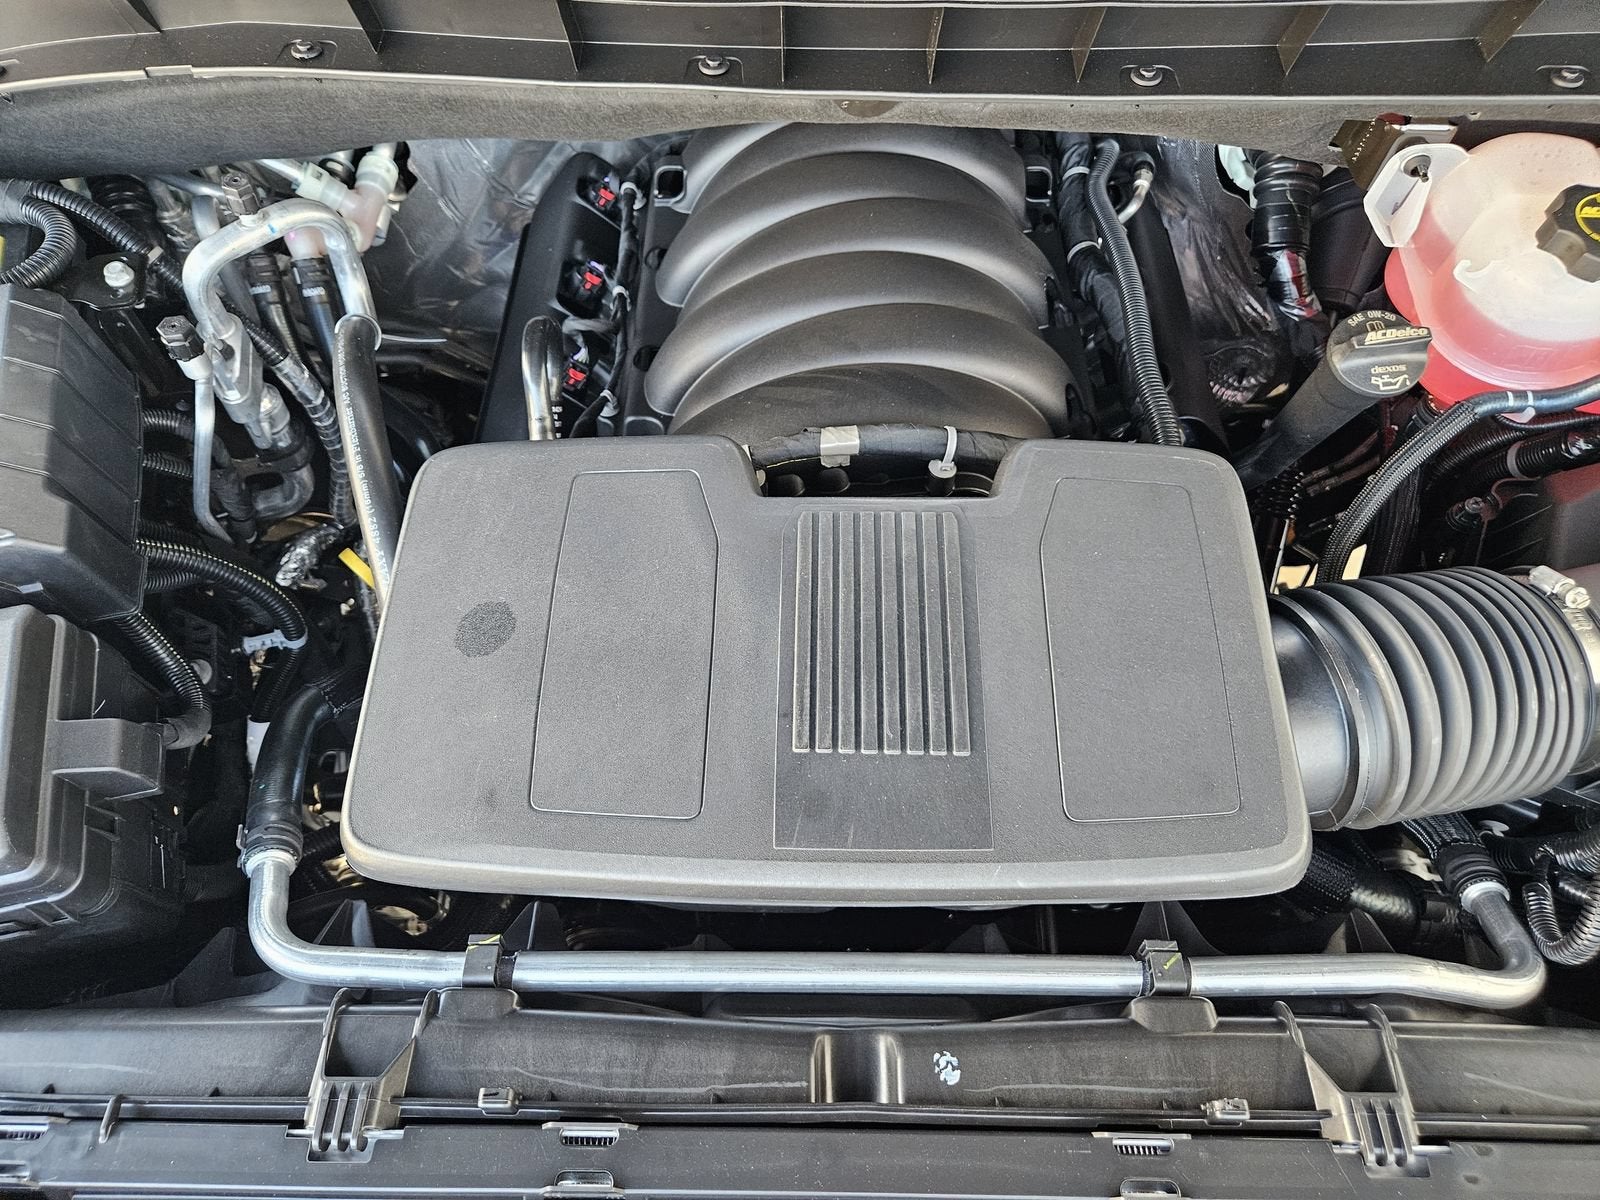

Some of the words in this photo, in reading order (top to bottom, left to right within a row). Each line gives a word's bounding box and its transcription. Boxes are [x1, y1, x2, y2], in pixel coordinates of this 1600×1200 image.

[1347, 313, 1365, 327] SAE
[1367, 310, 1396, 321] 0W-20
[1364, 327, 1428, 342] ACDelco
[1370, 364, 1407, 374] dexos
[346, 407, 360, 453] Flexbarrier
[355, 454, 362, 463] in
[360, 480, 375, 514] (16mm)
[368, 516, 381, 544] 4882
